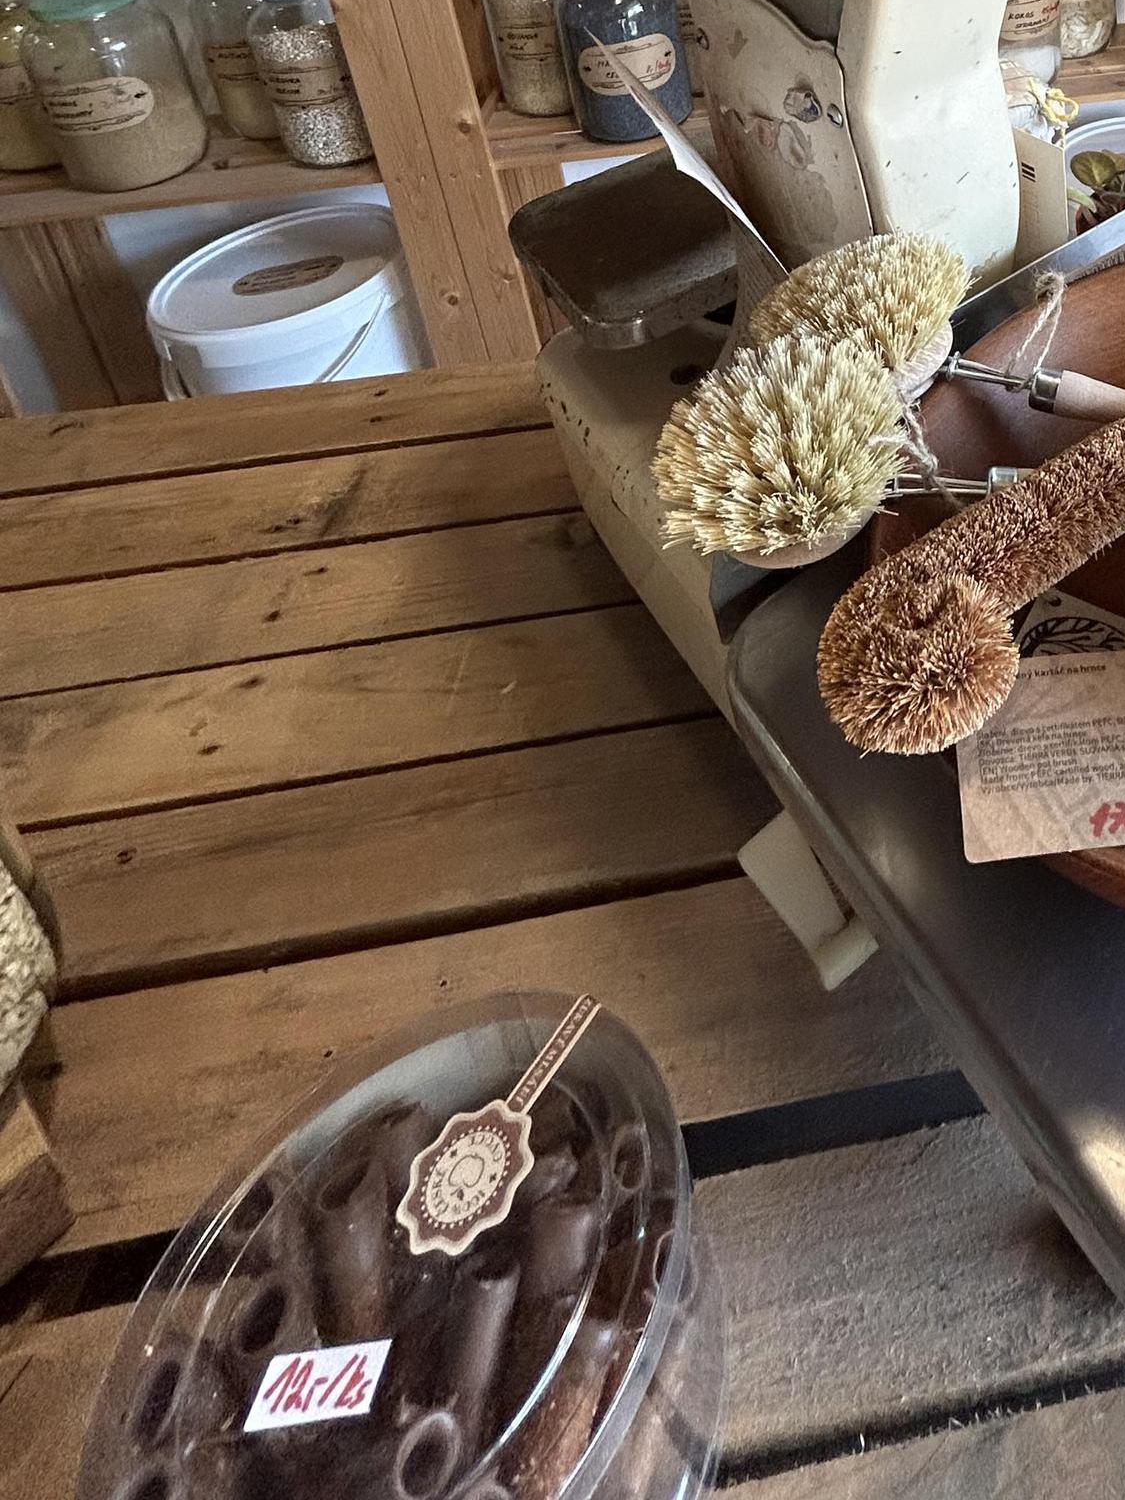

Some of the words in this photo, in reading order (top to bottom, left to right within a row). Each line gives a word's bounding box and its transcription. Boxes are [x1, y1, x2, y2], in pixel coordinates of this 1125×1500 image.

[1007, 11, 1035, 21] KOKOS
[1066, 666, 1078, 674] na
[1019, 750, 1049, 760] TIERRA
[998, 762, 1035, 772] Wooden
